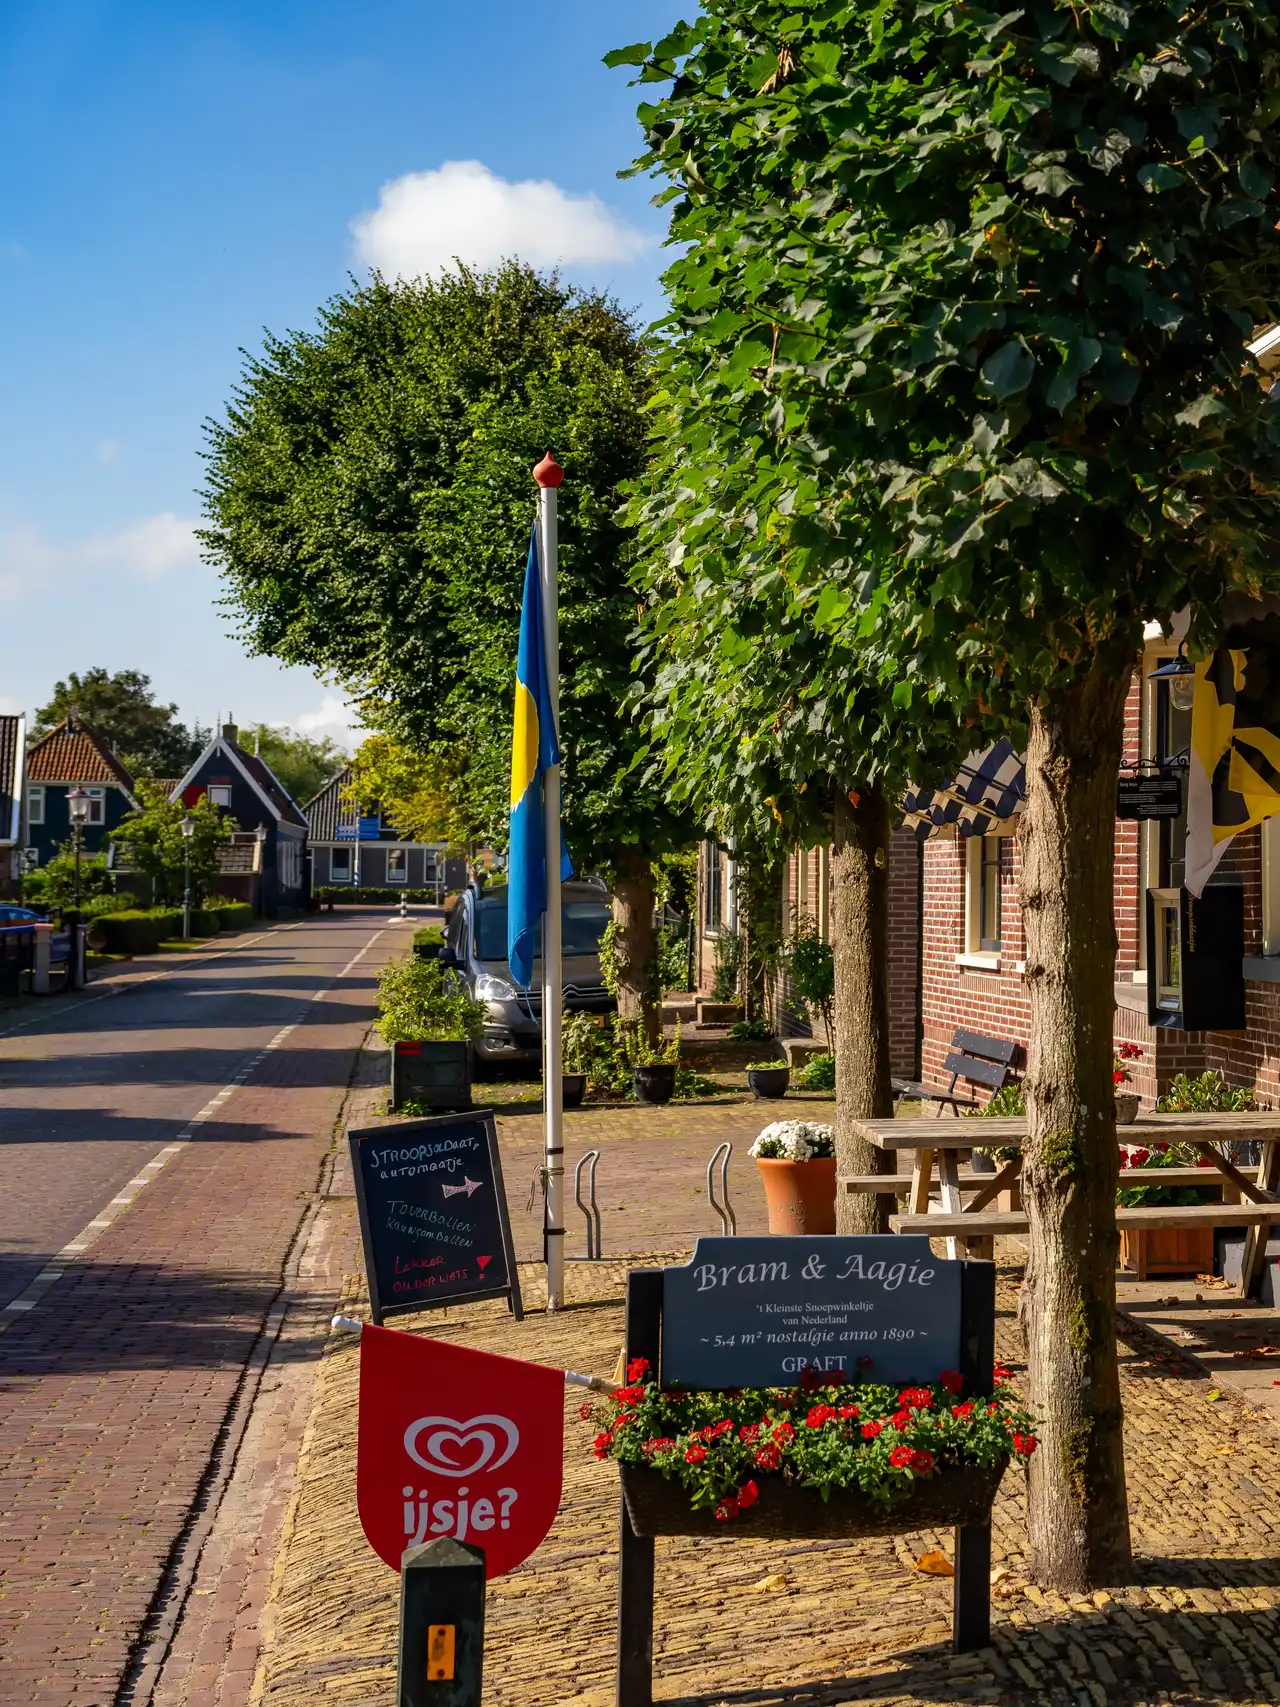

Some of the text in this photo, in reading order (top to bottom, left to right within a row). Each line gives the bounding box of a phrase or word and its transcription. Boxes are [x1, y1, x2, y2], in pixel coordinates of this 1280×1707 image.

[693, 1253, 935, 1292] Bram & Aagie
[765, 1302, 803, 1313] Kleinste
[805, 1301, 874, 1314] Snoepwinkeltje
[782, 1314, 848, 1325] van Nederland
[713, 1334, 736, 1348] 5,4
[766, 1328, 834, 1346] nostalgie
[839, 1331, 878, 1341] anno
[882, 1328, 915, 1342] 1890
[781, 1355, 847, 1373] GRAFT
[402, 1486, 519, 1548] ijsje?
